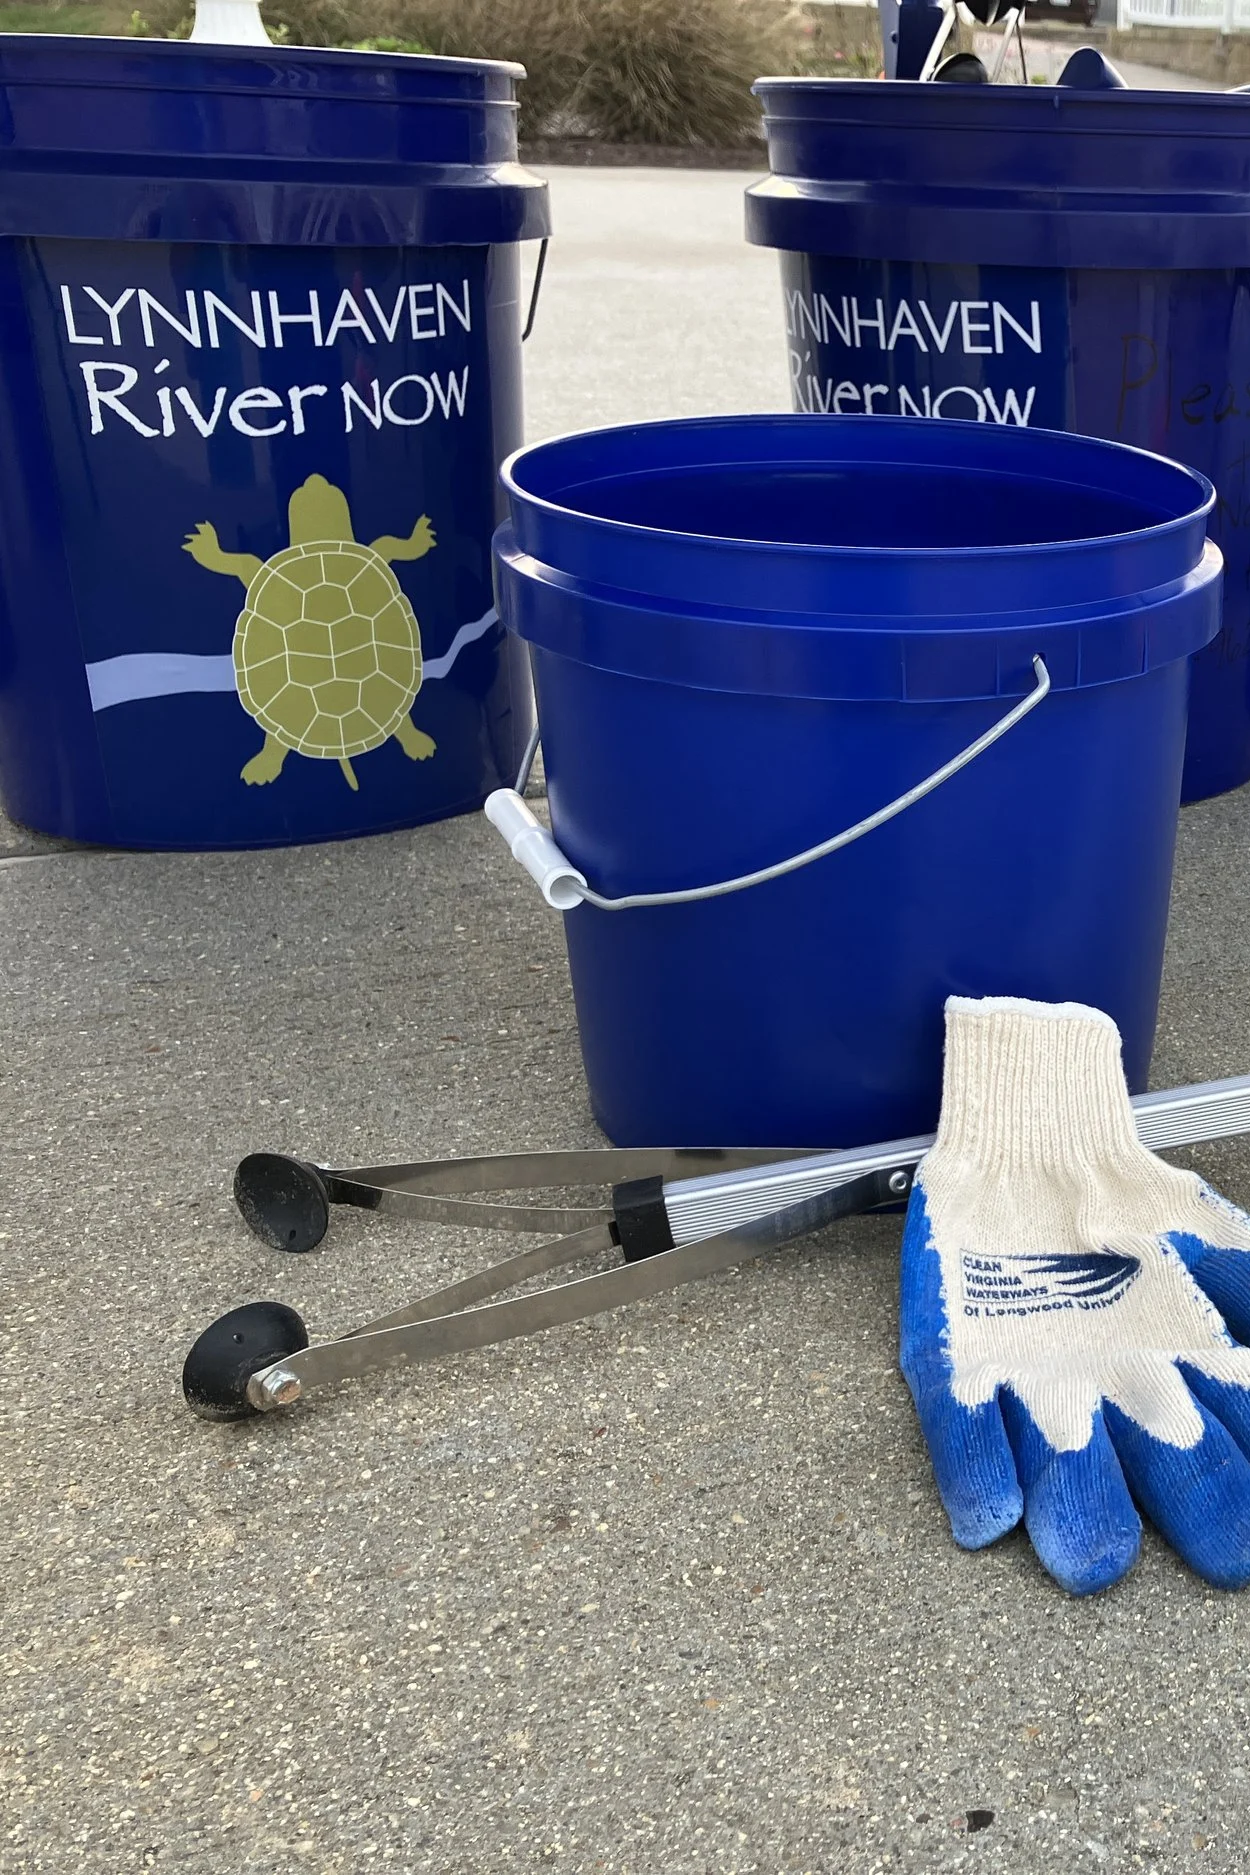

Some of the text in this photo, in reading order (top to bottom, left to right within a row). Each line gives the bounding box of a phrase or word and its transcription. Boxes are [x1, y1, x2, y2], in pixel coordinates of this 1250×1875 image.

[60, 279, 471, 348] LYNNHAVEN
[79, 358, 469, 438] River NOW
[788, 350, 1036, 428] River NOW
[963, 1255, 1003, 1273] CLEAN
[964, 1271, 1023, 1287] VIRGINIA
[965, 1286, 1049, 1301] WATERWAYS
[964, 1305, 979, 1318] Of
[985, 1299, 1074, 1317] Longwood
